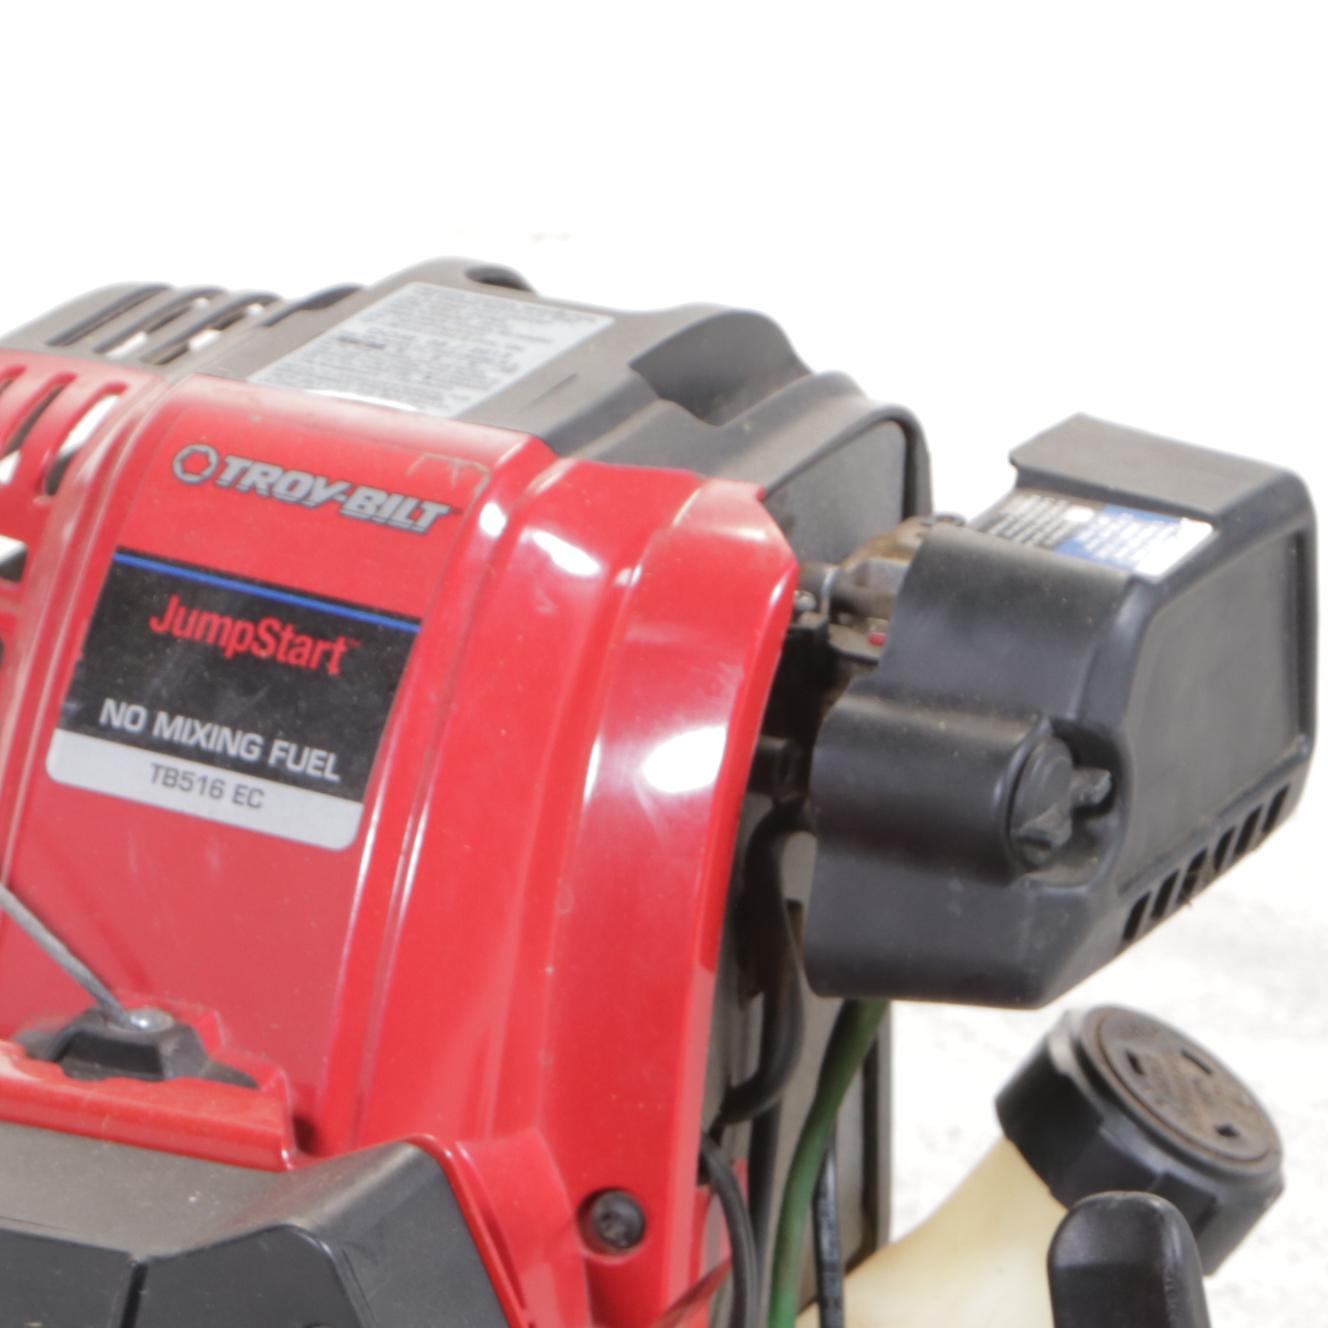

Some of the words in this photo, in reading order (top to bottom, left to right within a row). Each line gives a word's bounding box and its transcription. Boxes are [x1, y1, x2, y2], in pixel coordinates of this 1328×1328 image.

[215, 455, 452, 535] TROY-BILT
[149, 594, 350, 677] JumpStart
[99, 698, 147, 733] NO
[153, 711, 264, 762] MIXING
[269, 739, 341, 783] FUEL
[149, 763, 226, 800] TB516
[232, 786, 265, 811] EC
